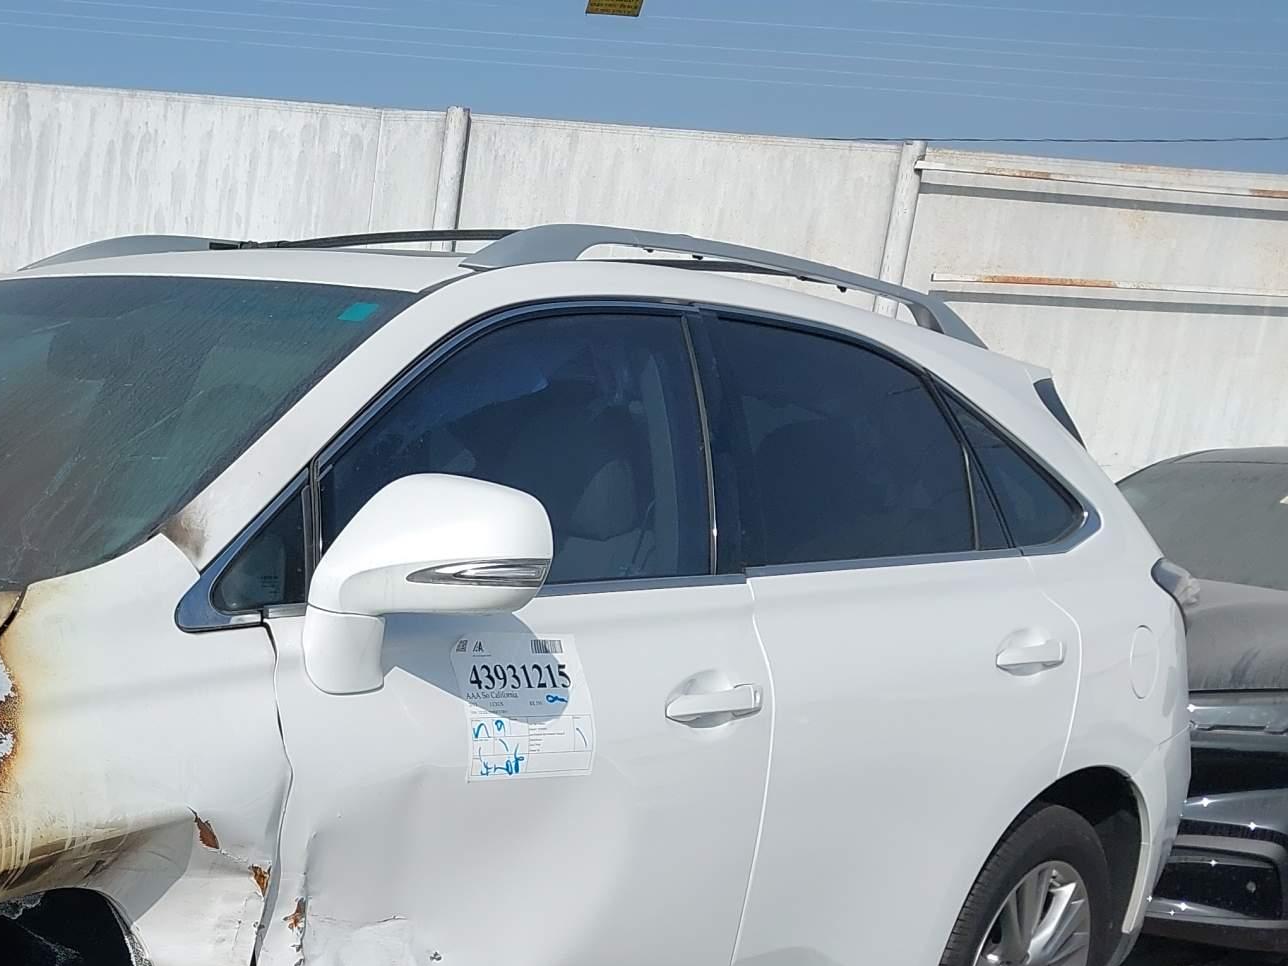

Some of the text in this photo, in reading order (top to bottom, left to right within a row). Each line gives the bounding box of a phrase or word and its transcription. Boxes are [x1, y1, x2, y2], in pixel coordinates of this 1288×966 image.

[469, 663, 572, 690] 43931215
[466, 692, 481, 700] AAA
[490, 690, 519, 699] California
